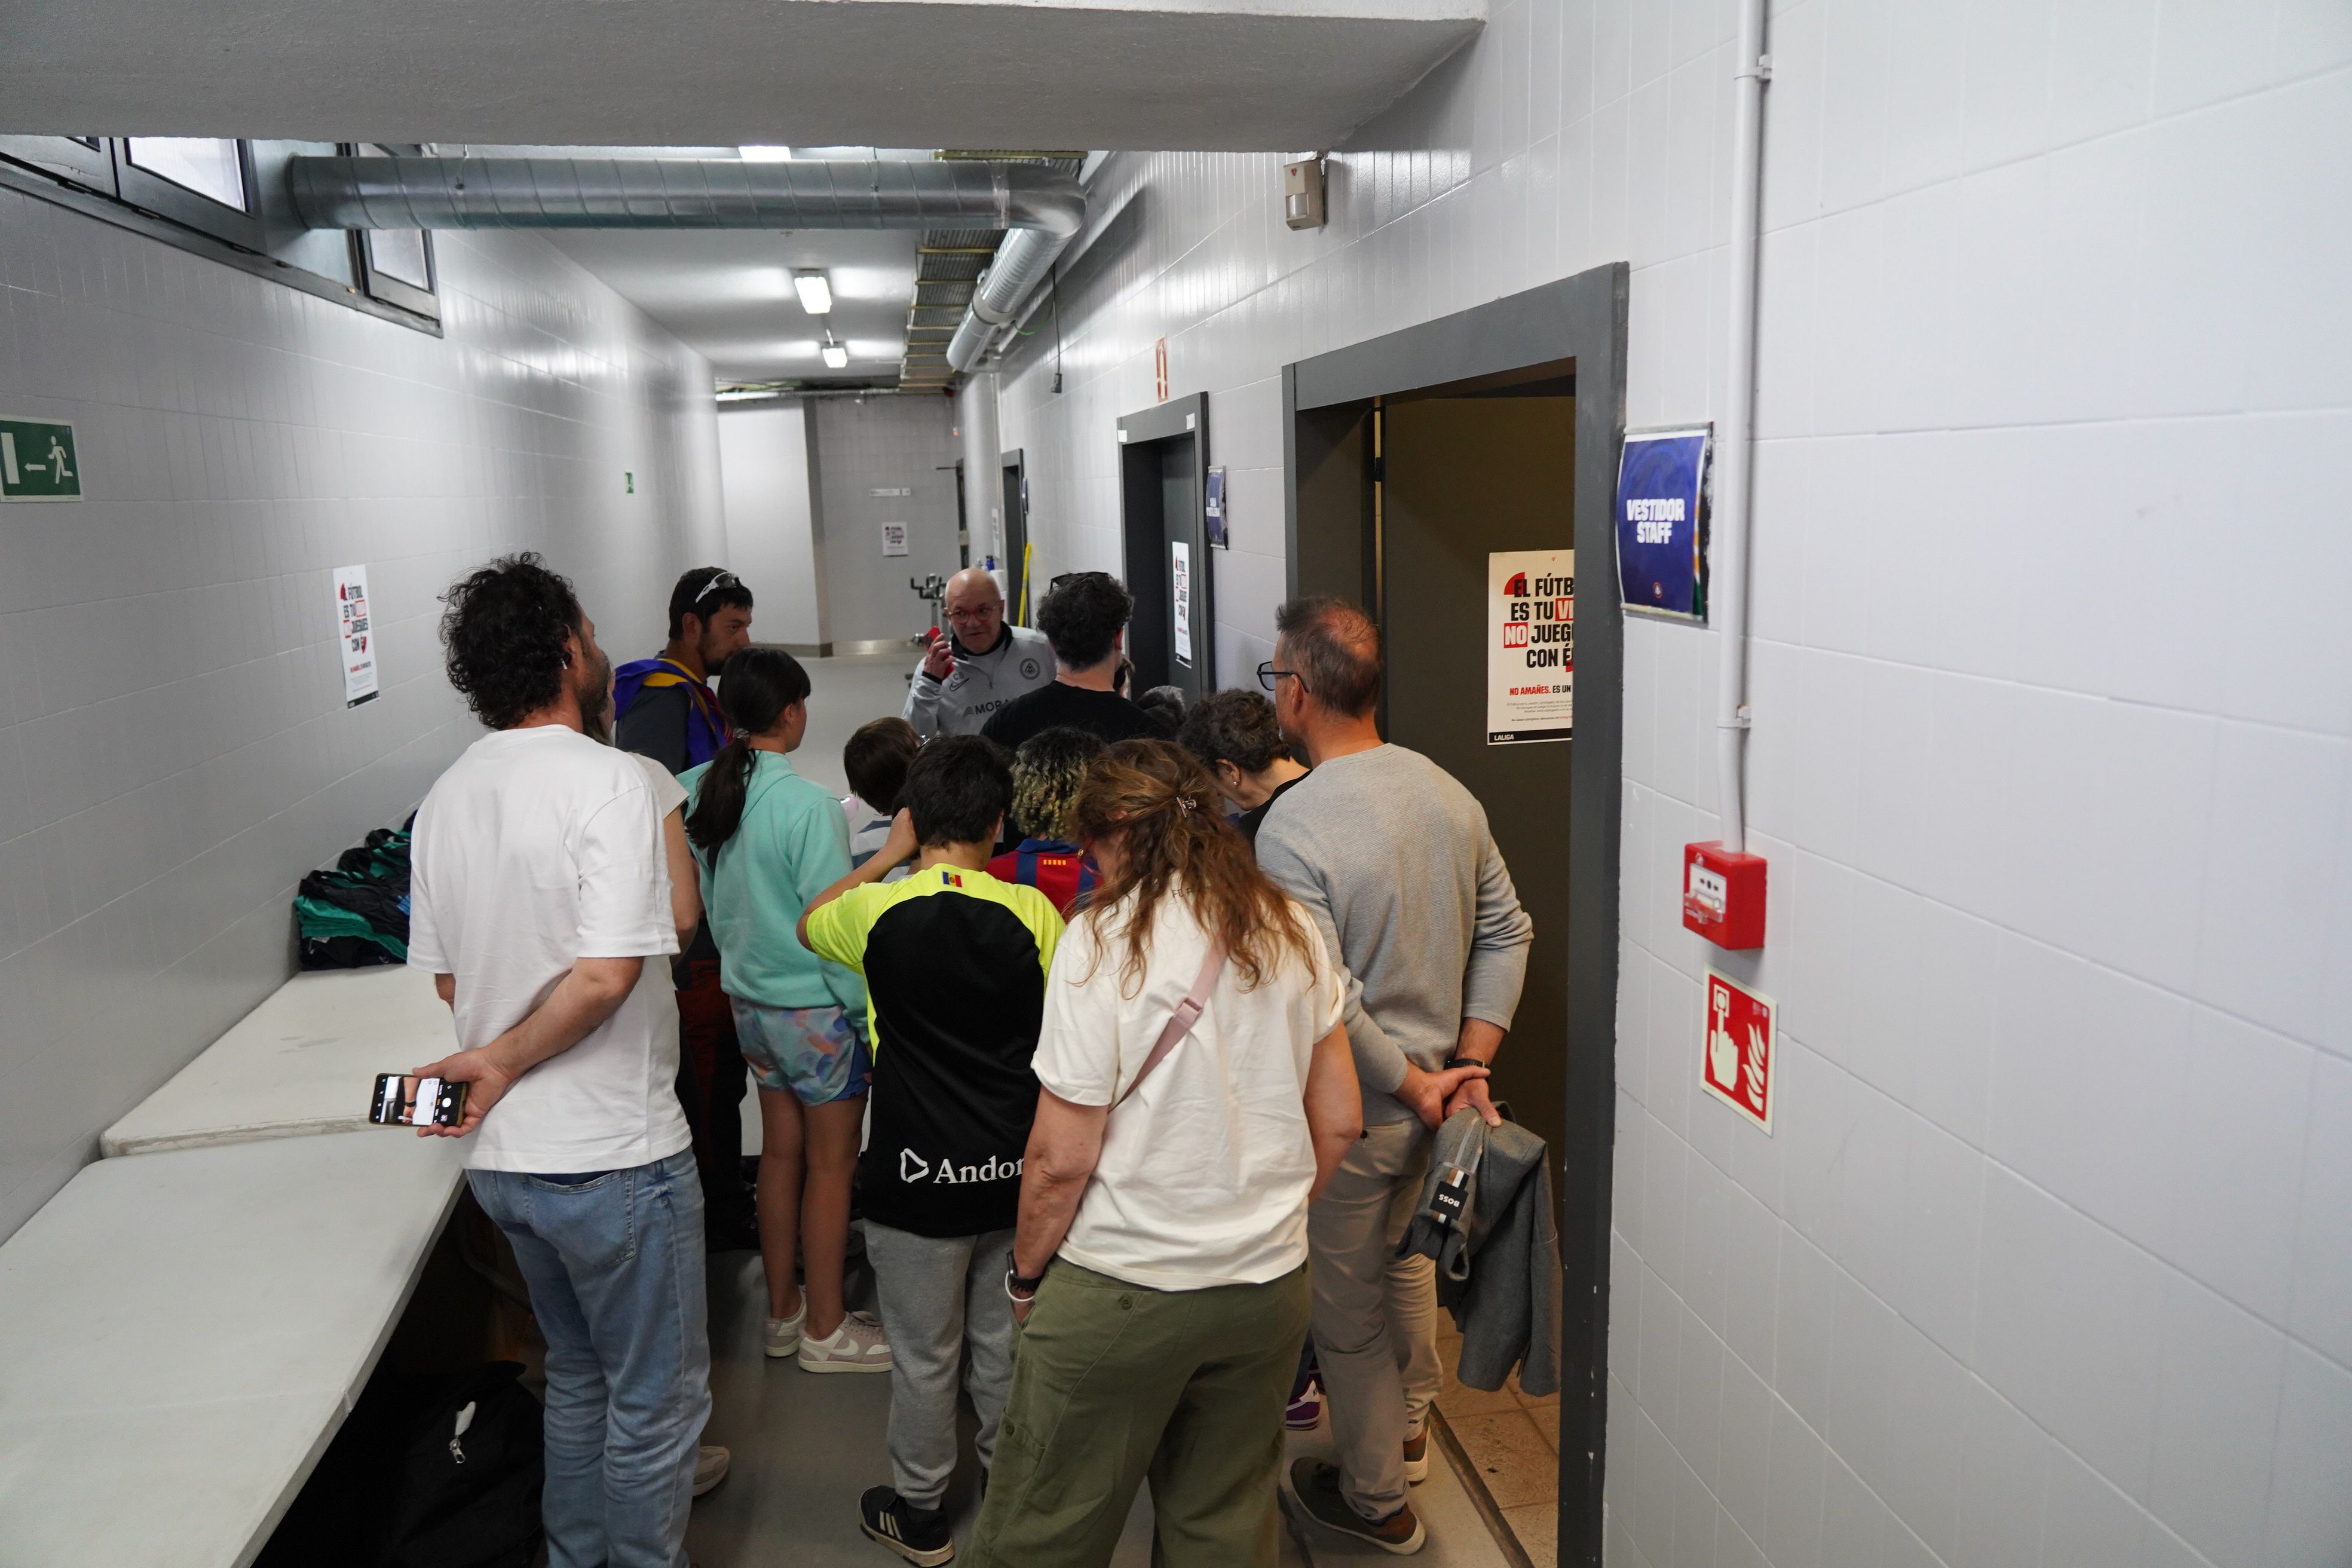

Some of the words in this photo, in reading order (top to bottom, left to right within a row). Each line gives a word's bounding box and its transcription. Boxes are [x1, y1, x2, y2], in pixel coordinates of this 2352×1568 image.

[1627, 498, 1685, 522] VESTIDOR
[1637, 521, 1672, 544] STAFF
[1514, 579, 1530, 598] EL
[1511, 602, 1530, 621] ES
[1534, 601, 1554, 620] TU
[1505, 625, 1527, 646] NO
[1526, 649, 1558, 668] CON
[1509, 687, 1519, 696] NO
[1520, 684, 1551, 695] AMAÑES.
[1438, 1193, 1460, 1207] BOSS
